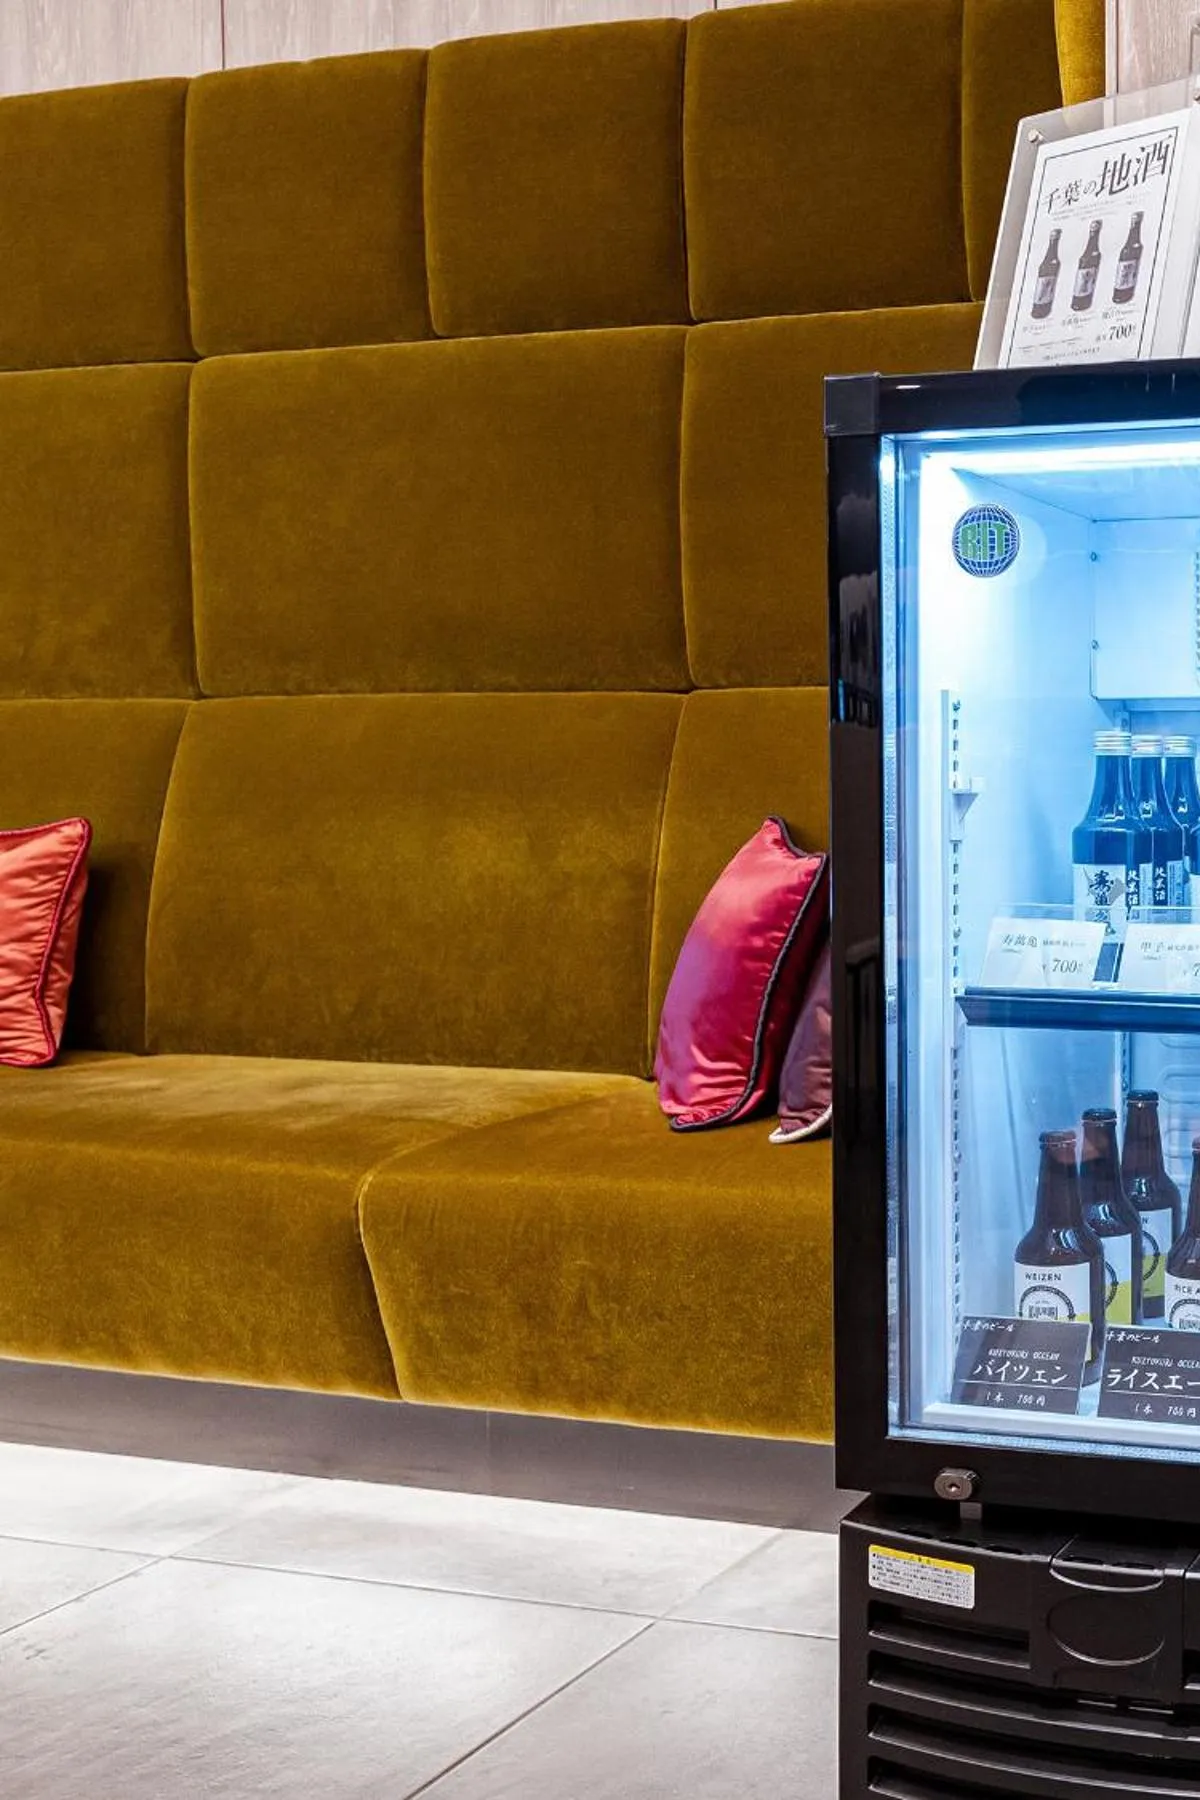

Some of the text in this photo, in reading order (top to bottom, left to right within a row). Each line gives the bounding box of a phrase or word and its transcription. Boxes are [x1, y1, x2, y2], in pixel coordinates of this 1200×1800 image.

[1041, 134, 1173, 214] 千葉の地酒
[972, 1359, 1069, 1385] バイツェン
